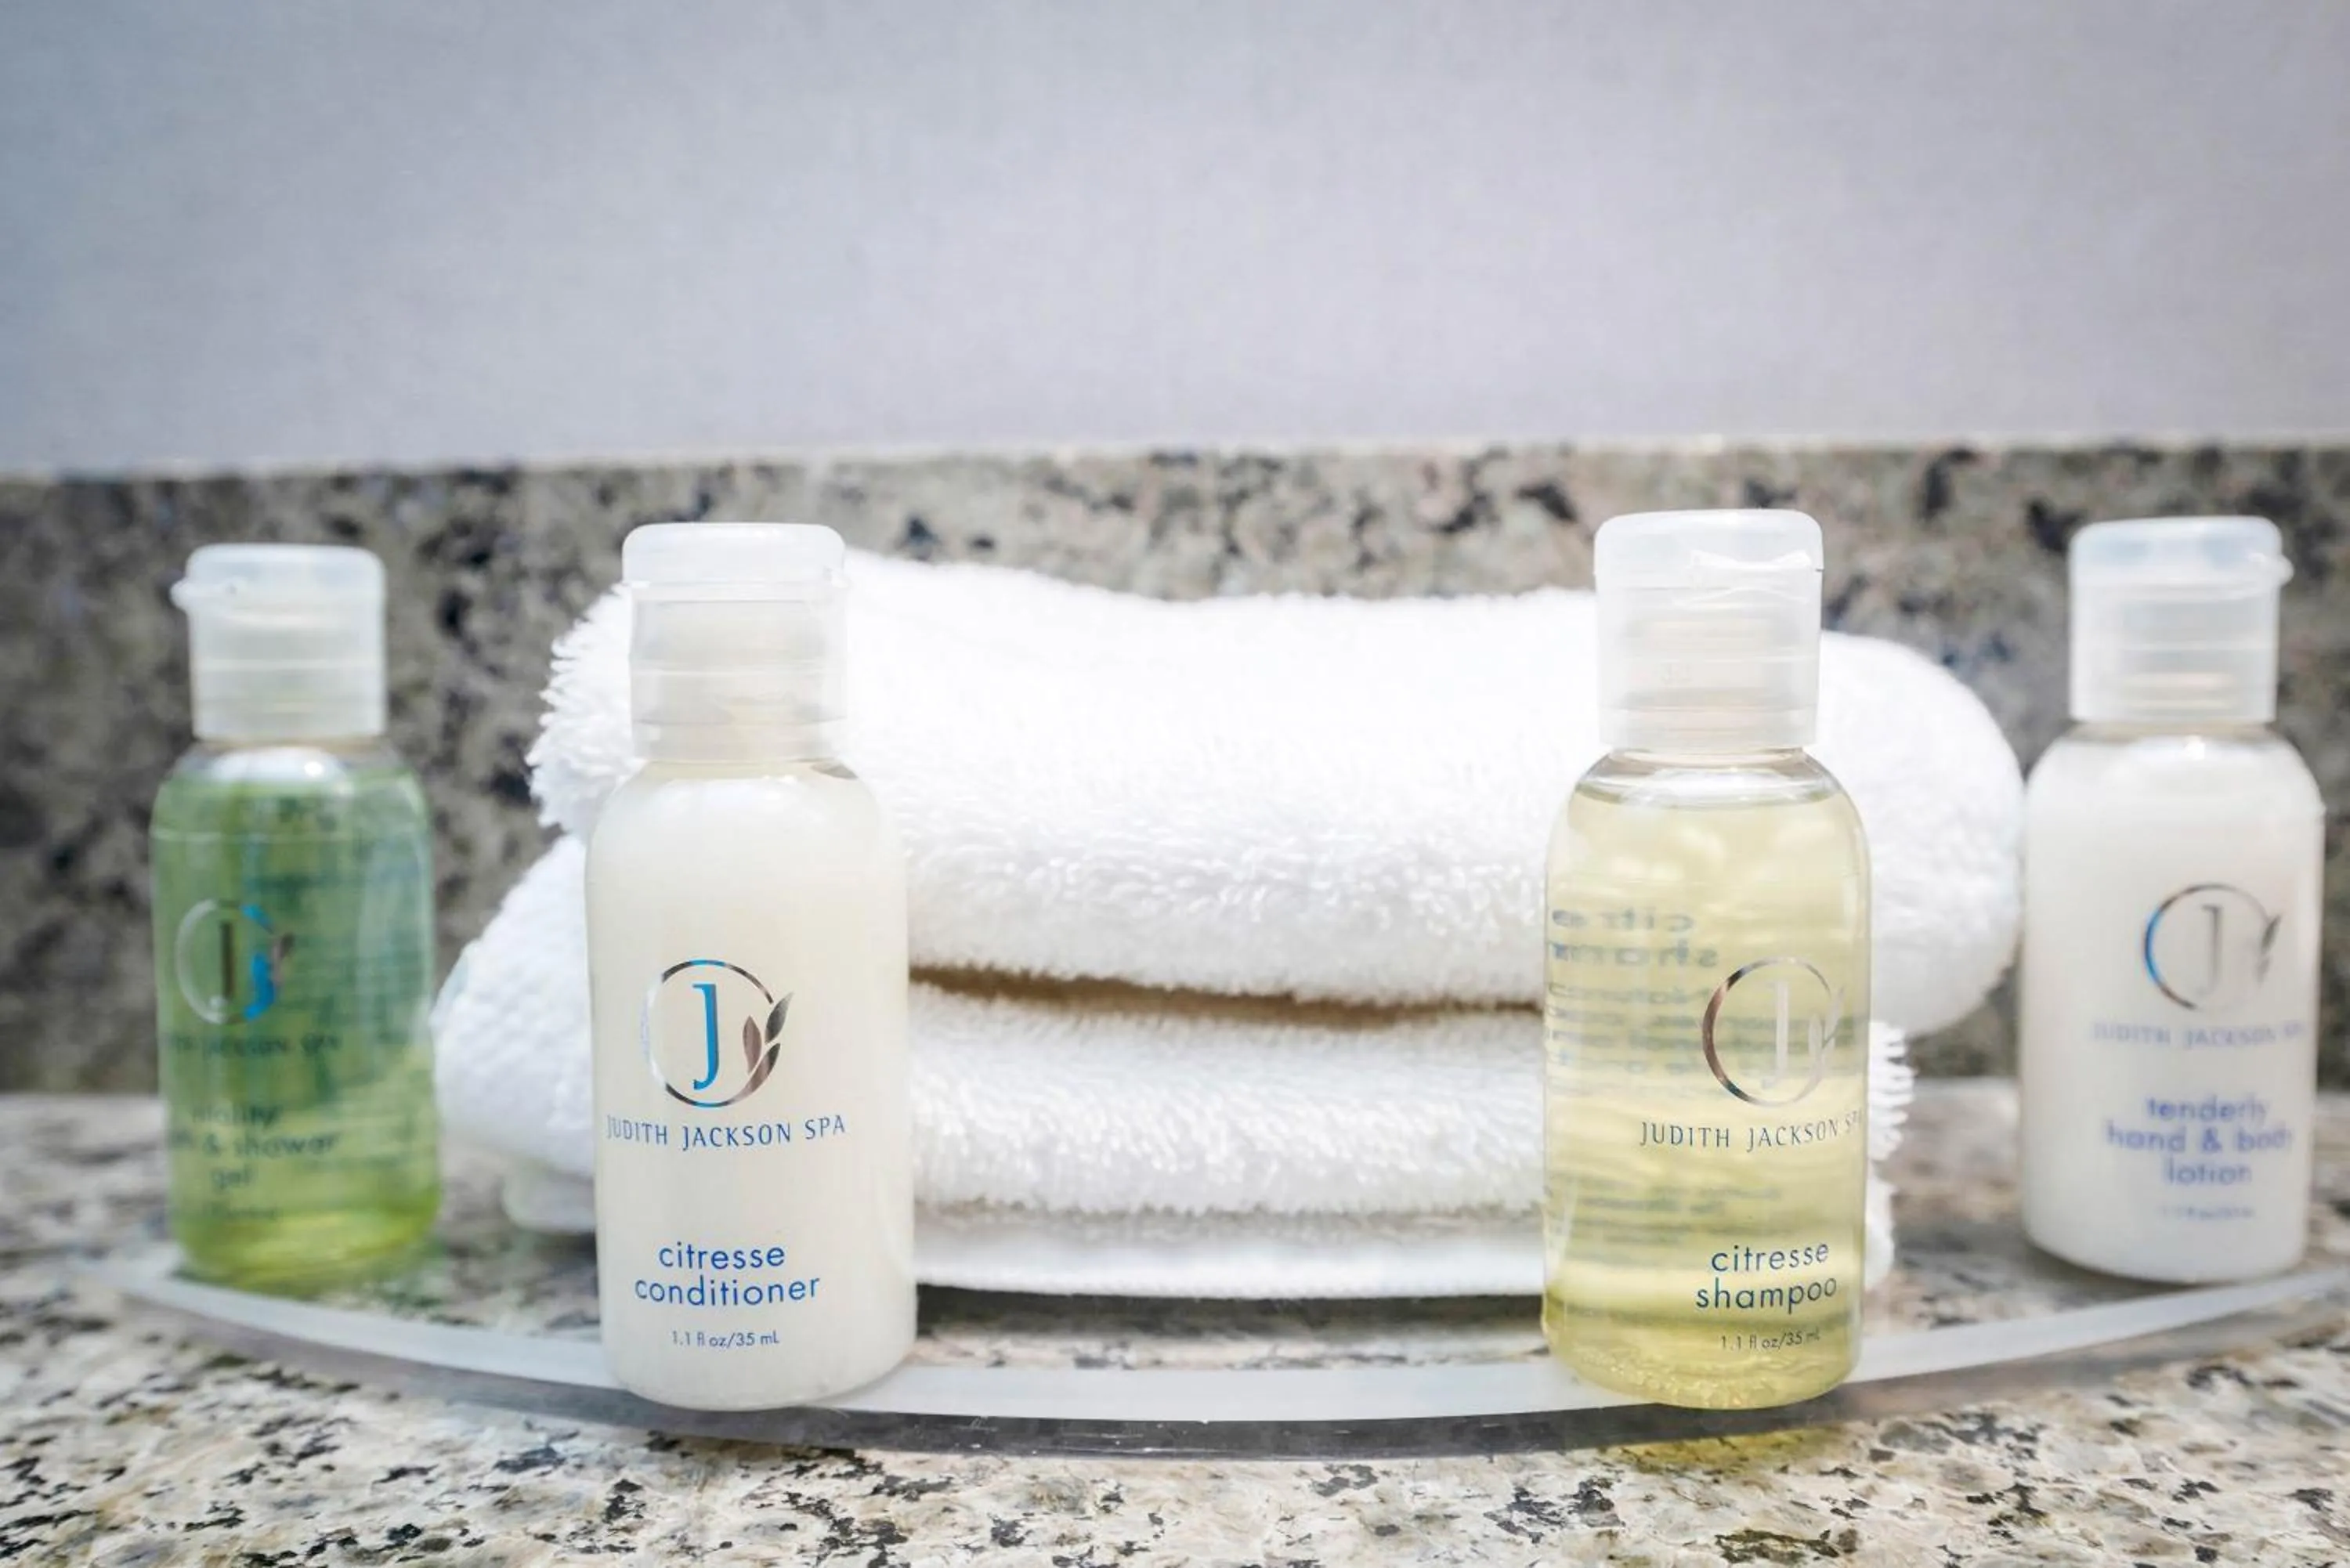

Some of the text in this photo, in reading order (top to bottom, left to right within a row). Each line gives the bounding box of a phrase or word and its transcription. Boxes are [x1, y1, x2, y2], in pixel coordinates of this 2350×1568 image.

[692, 983, 720, 1091] J
[607, 1114, 847, 1151] JUDITH JACKSON SPA
[1640, 1121, 1730, 1149] JUDITH
[1746, 1118, 1839, 1153] JACKSON
[2106, 1118, 2186, 1152] hand
[2202, 1126, 2223, 1152] &
[2164, 1154, 2253, 1186] lotion
[658, 1241, 786, 1270] citresse
[1711, 1243, 1829, 1273] citresse
[634, 1274, 821, 1308] conditioner
[1695, 1277, 1838, 1315] shampoo
[672, 1329, 779, 1348] 1.1 fl oz/35 mL
[1721, 1335, 1741, 1350] 1.1
[1761, 1330, 1802, 1351] oz/35
